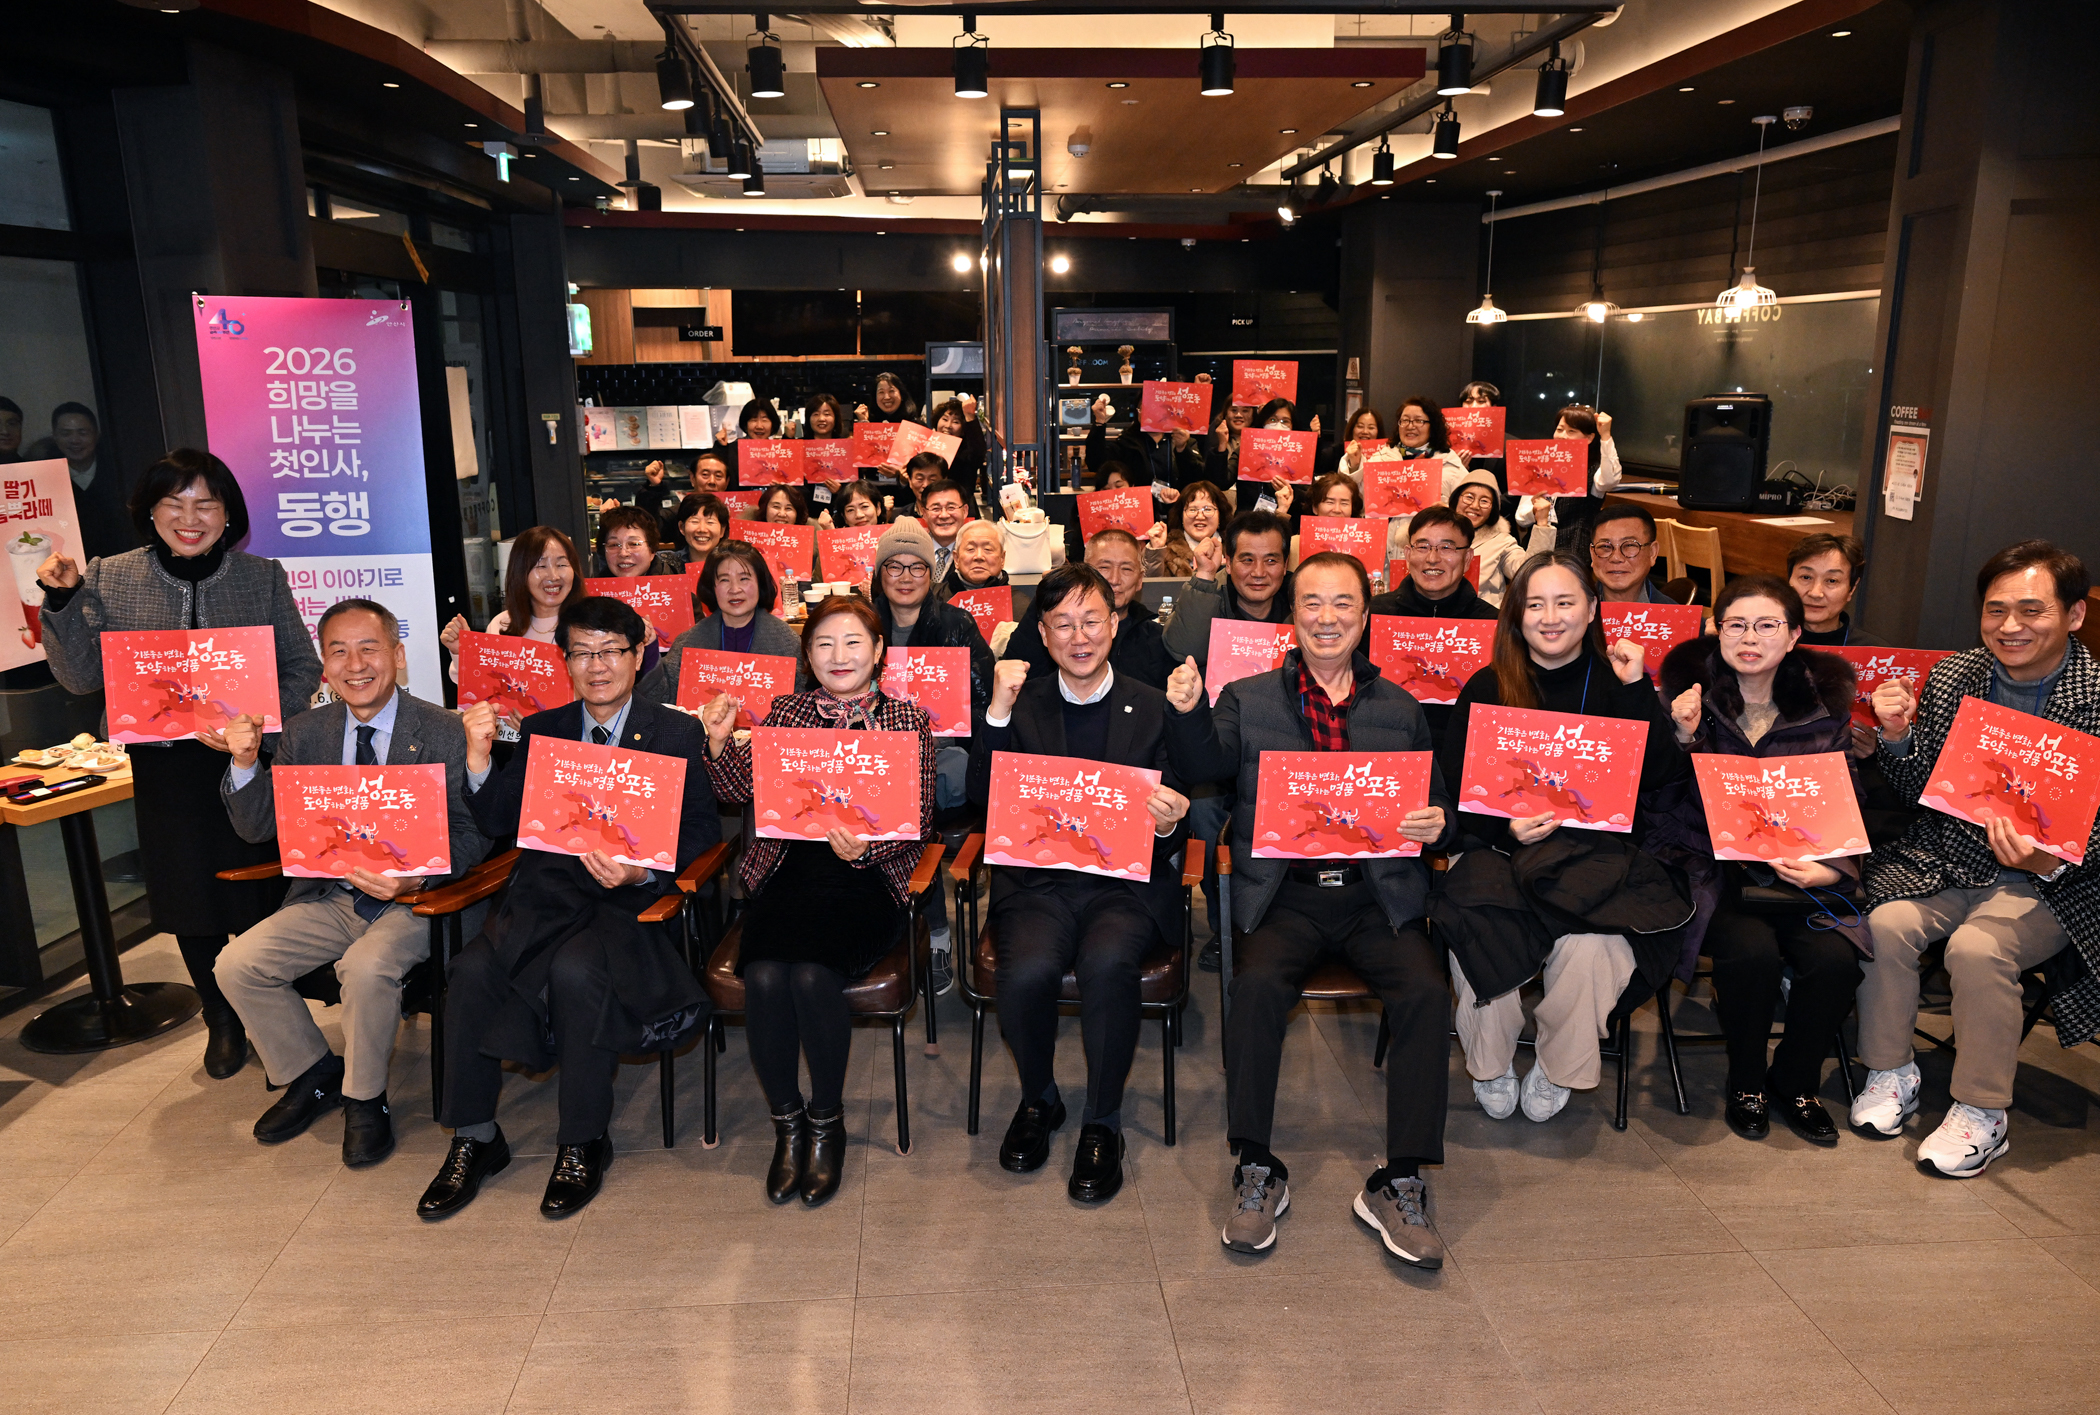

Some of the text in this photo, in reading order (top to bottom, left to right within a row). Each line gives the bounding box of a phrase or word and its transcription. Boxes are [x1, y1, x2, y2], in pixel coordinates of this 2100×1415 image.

[263, 347, 357, 375] 2026
[266, 380, 358, 410] 희망을
[271, 414, 362, 444] 나누는
[270, 448, 368, 482] 첫인사,
[4, 479, 36, 500] 딸기
[1758, 491, 1782, 500] MIPRO
[277, 491, 371, 538] 동행
[858, 530, 880, 549] 성포
[323, 568, 404, 588] 이야기로
[1611, 624, 1632, 638] 명품
[134, 650, 162, 659] 기분좋은
[1425, 640, 1444, 653] 명품
[135, 661, 177, 675] 도약하는
[176, 657, 200, 673] 명품
[509, 658, 525, 672] 명품
[726, 673, 742, 686] 명품
[897, 669, 914, 682] 명품
[1497, 726, 1527, 737] 기분좋은
[1981, 724, 2011, 740] 기분좋은
[780, 748, 808, 757] 기분좋은
[1496, 736, 1539, 754] 도약하는
[1539, 740, 1564, 757] 명품
[1976, 734, 2018, 759] 도약하는
[2020, 750, 2042, 766] 명품
[554, 758, 582, 770] 기분좋은
[780, 758, 822, 773] 도약하는
[821, 757, 845, 774] 명품
[553, 769, 593, 787] 도약하는
[593, 773, 615, 791] 명품
[1019, 774, 1048, 784] 기분좋은
[1288, 772, 1317, 781] 기분좋은
[302, 786, 332, 795] 기분좋은
[1019, 784, 1060, 800] 도약하는
[1060, 785, 1083, 803] 명품
[1288, 782, 1330, 796] 도약하는
[1330, 780, 1354, 796] 명품
[1724, 782, 1758, 796] 도약하는
[1756, 786, 1776, 800] 명품
[303, 796, 346, 811] 도약하는
[345, 794, 369, 810] 명품
